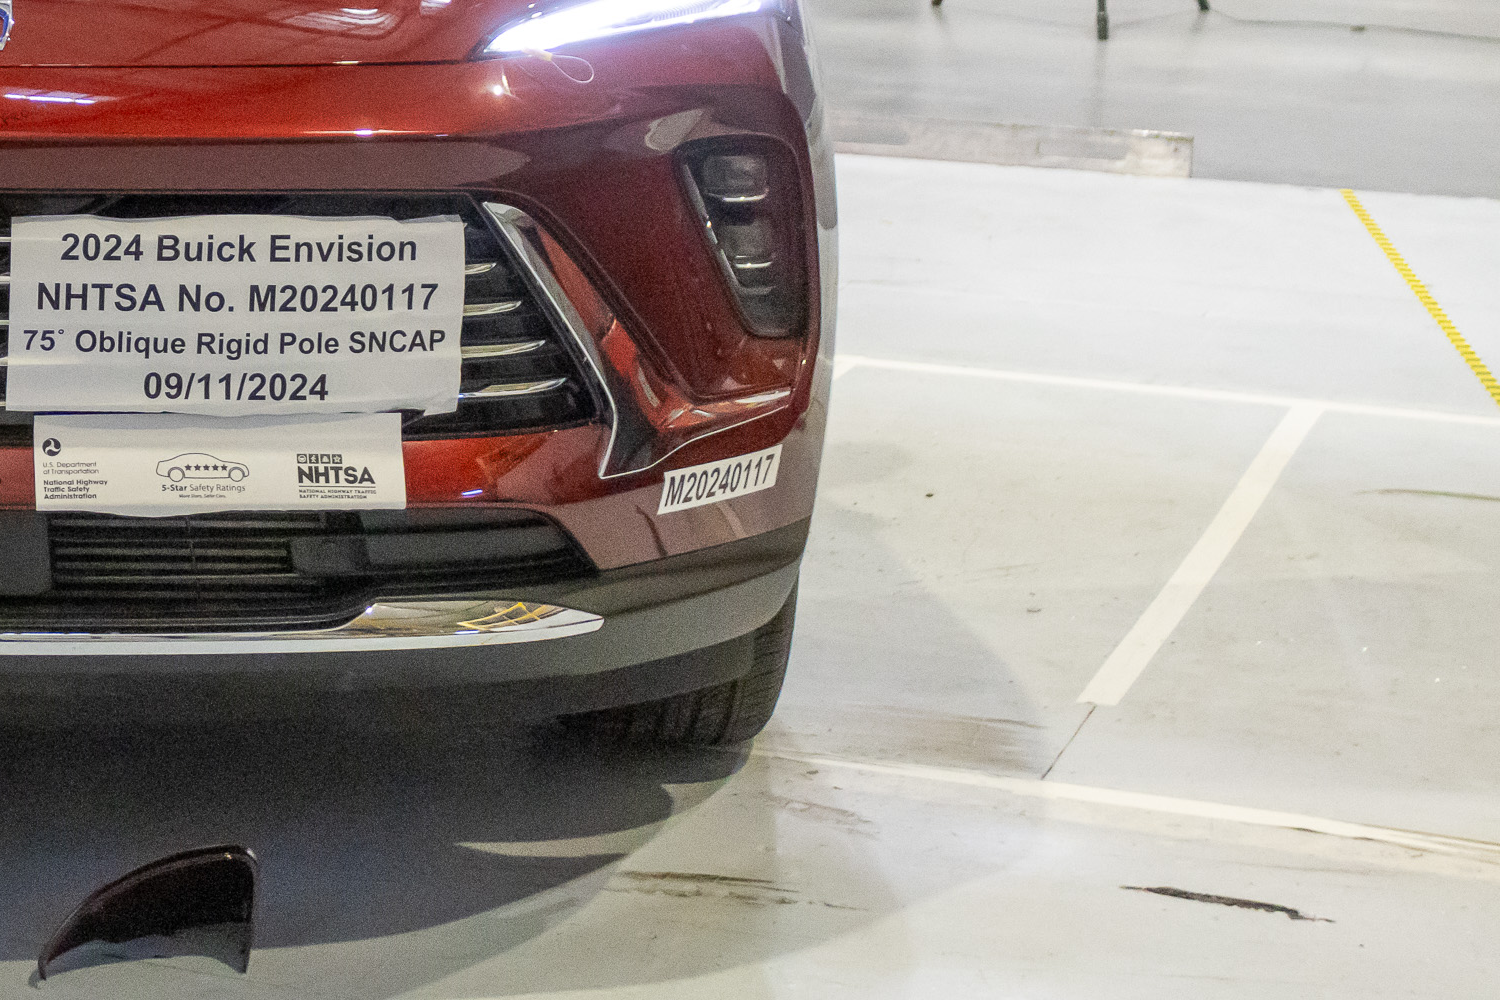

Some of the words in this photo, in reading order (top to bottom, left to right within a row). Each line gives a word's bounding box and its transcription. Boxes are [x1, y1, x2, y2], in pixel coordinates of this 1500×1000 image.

[60, 233, 144, 262] 2024
[156, 234, 256, 263] Buick
[269, 234, 417, 263] Envision
[37, 282, 166, 312] NHTSA
[178, 284, 234, 313] No.
[248, 283, 439, 313] M20240117
[75, 329, 186, 360] Oblique
[196, 332, 269, 361] Rigid
[279, 331, 340, 355] Pole
[348, 329, 446, 354] SNCAP
[143, 371, 329, 402] 09/11/2024
[161, 484, 188, 492] 5-Star
[189, 484, 214, 493] Safety
[216, 484, 246, 493] Ratings
[297, 466, 376, 484] NHTSA
[664, 453, 775, 507] M20240117
